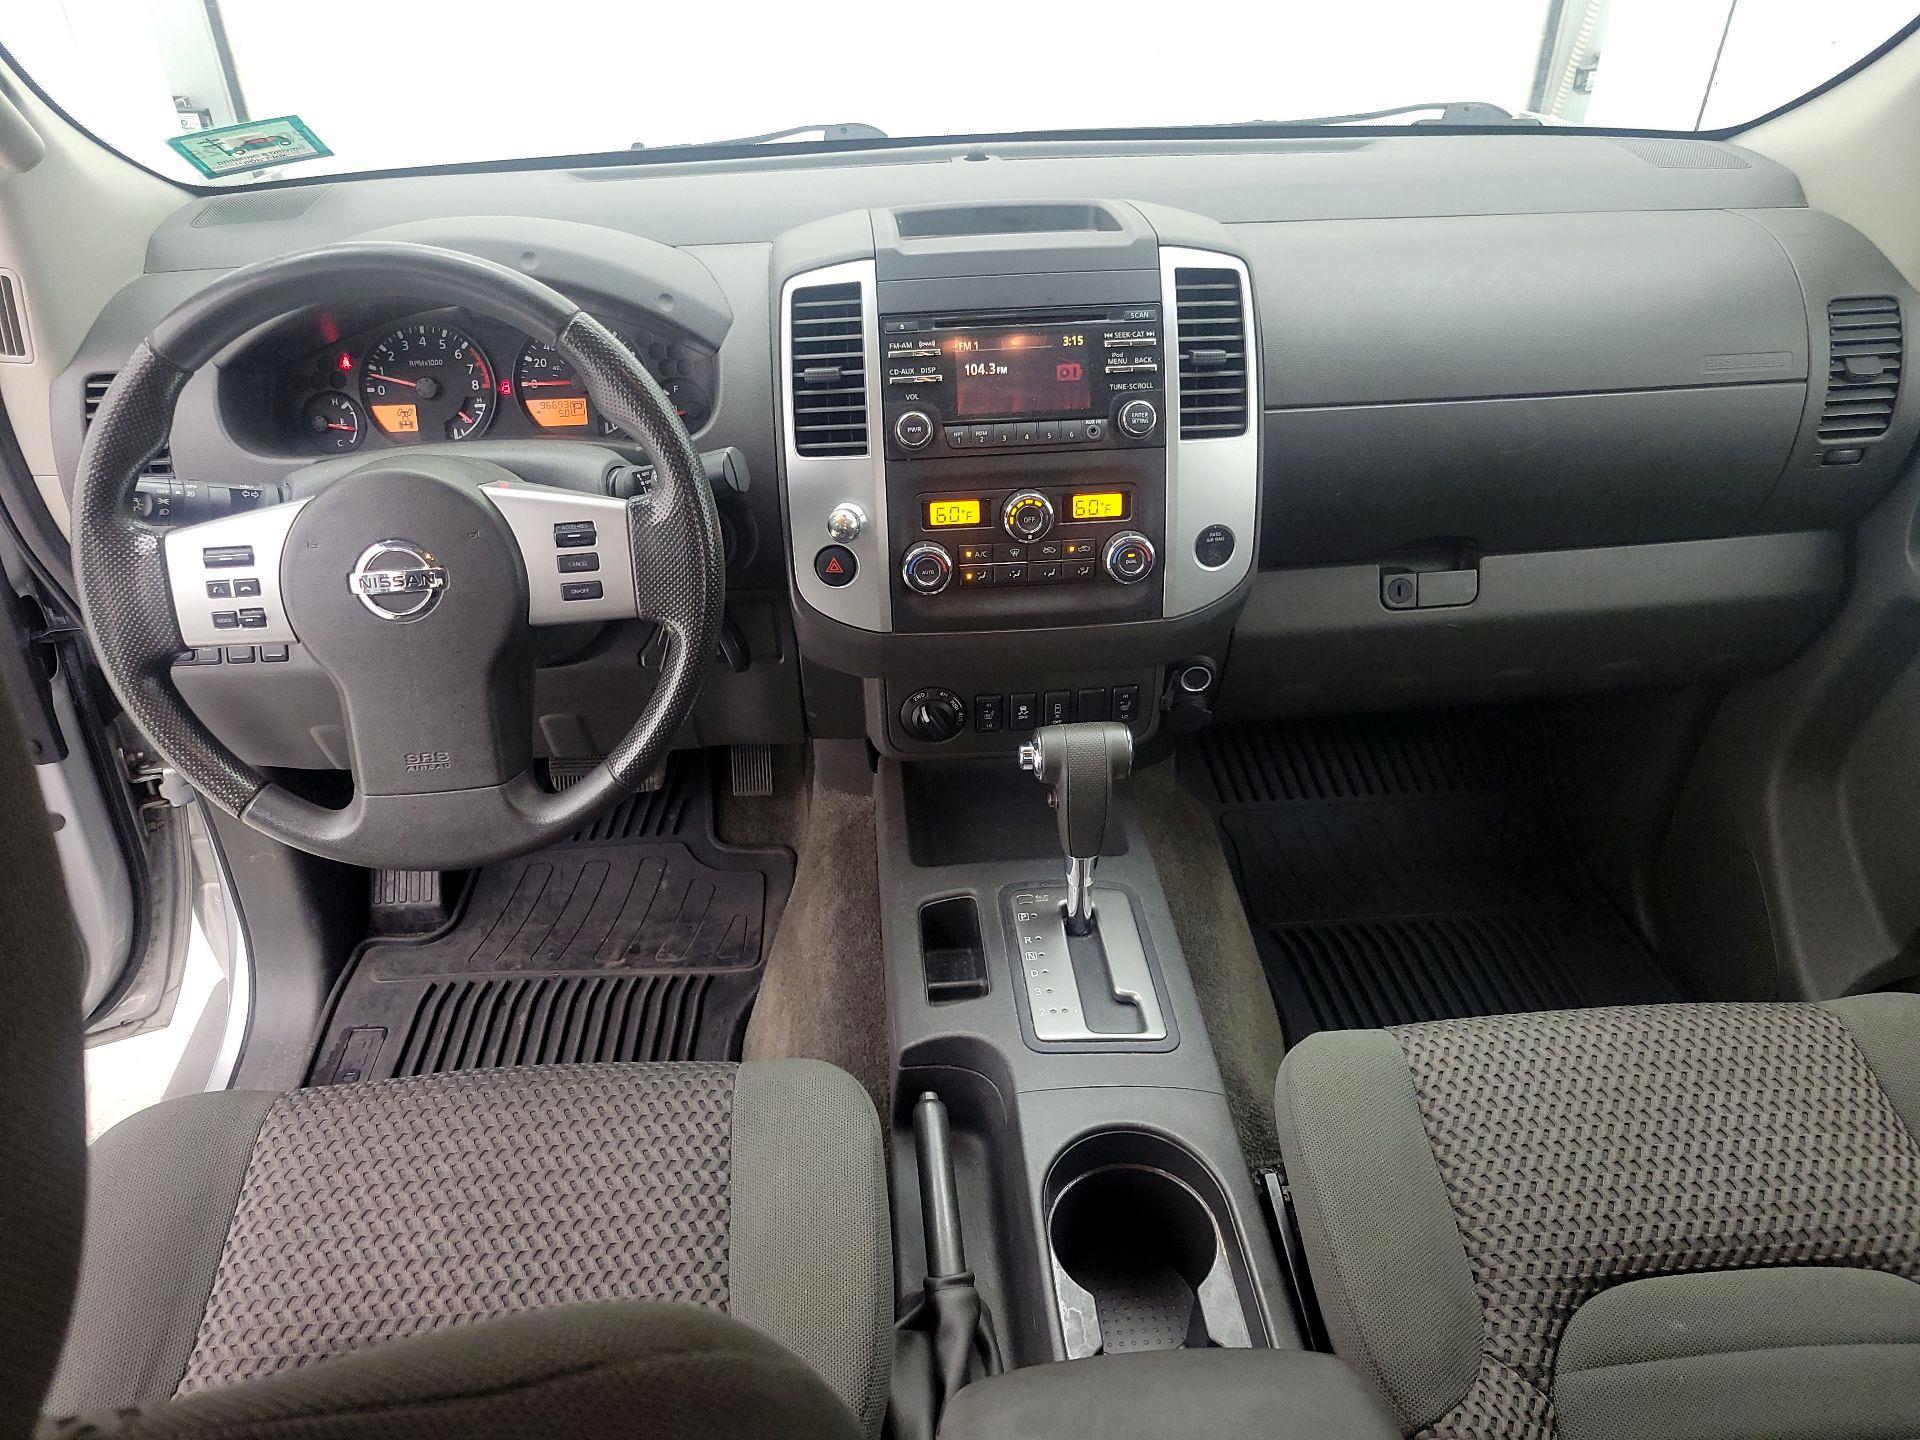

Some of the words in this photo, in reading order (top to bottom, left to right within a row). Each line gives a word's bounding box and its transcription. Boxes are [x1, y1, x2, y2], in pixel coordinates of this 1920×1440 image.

[419, 337, 426, 346] 4
[440, 340, 446, 349] 5
[1062, 335, 1084, 346] 3:15
[402, 341, 409, 350] 3
[959, 341, 972, 351] FM
[388, 352, 395, 361] 2
[454, 350, 462, 359] 6
[533, 358, 547, 368] 20
[467, 364, 474, 374] 7
[964, 363, 996, 376] 104.3
[996, 366, 1008, 374] FM
[472, 380, 479, 390] 8
[673, 385, 679, 393] F
[378, 386, 385, 395] 0
[1023, 516, 1036, 524] OFF
[359, 571, 436, 589] NISSAN
[1031, 969, 1039, 977] D
[1035, 987, 1042, 995] 3
[1040, 1008, 1047, 1016] 2
